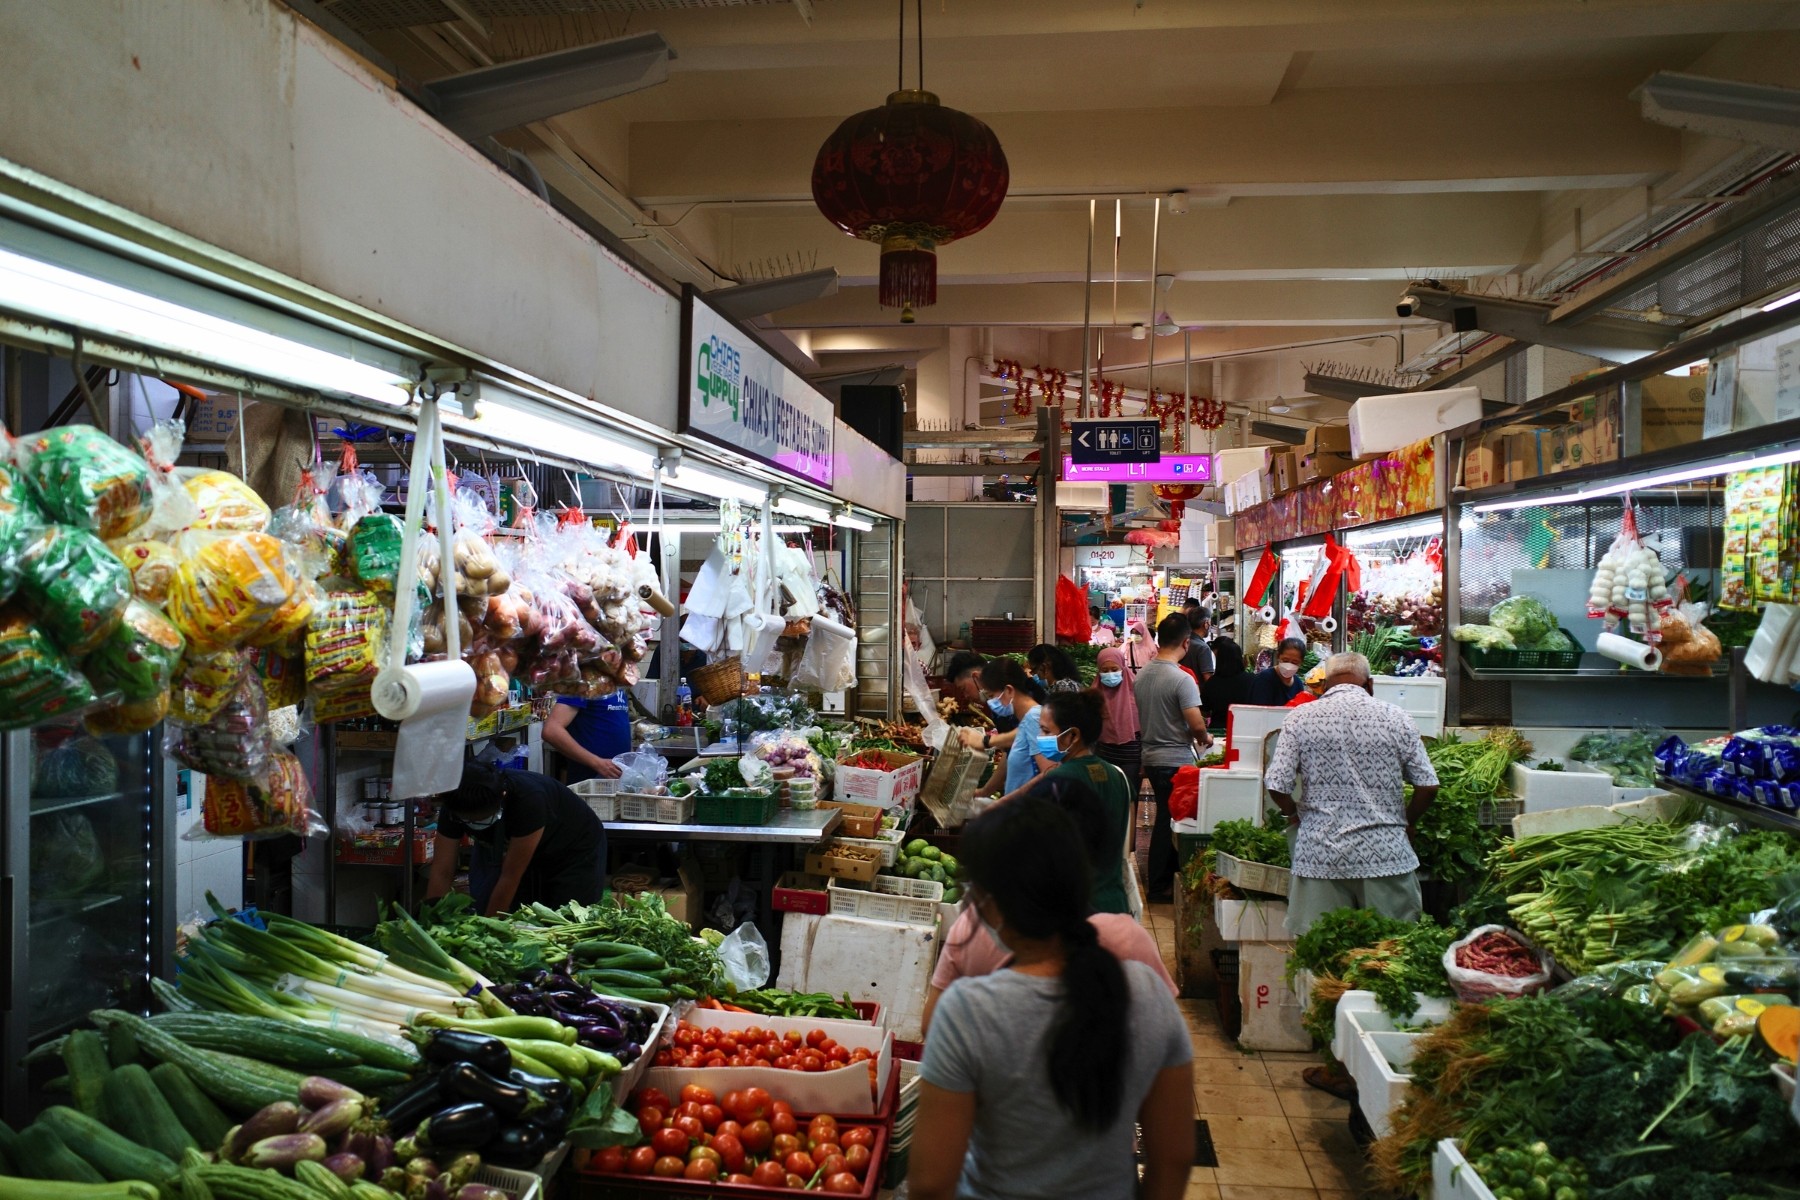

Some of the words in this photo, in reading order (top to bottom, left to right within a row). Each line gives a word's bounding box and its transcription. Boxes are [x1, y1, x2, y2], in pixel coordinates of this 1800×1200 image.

[711, 335, 740, 374] CHIA'S
[711, 359, 739, 387] VEGETABLES
[218, 410, 237, 419] 9.5"
[743, 375, 769, 437] CHIA'S
[772, 393, 809, 458] VEGETABLES
[812, 419, 830, 467] SUPPLY
[1130, 463, 1145, 474] L1
[1256, 984, 1269, 1009] TG
